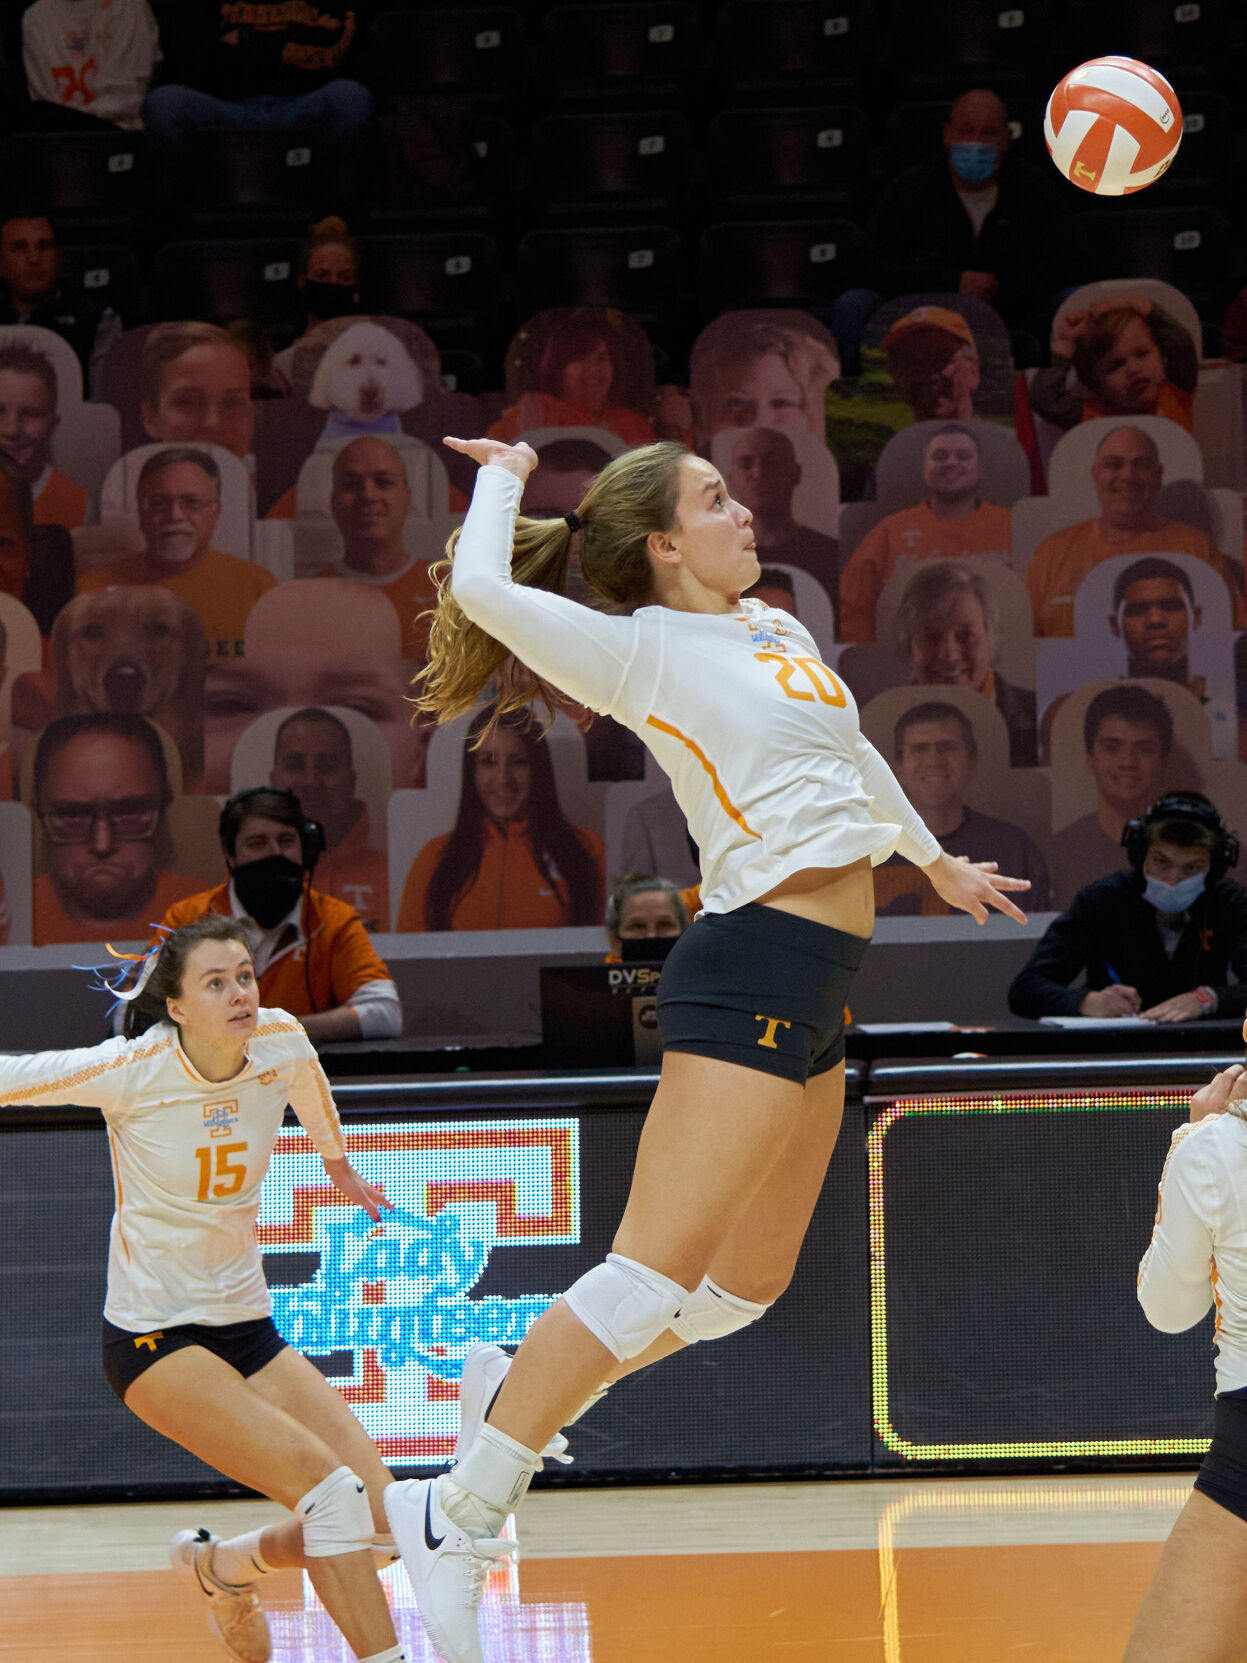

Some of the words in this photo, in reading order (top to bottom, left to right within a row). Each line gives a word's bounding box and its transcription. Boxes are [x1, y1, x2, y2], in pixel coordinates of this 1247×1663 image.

[1073, 160, 1097, 181] T
[902, 530, 922, 547] T
[753, 652, 848, 709] 20
[342, 884, 374, 911] T
[755, 1014, 792, 1049] T
[194, 1141, 248, 1201] 15
[134, 1331, 165, 1353] T
